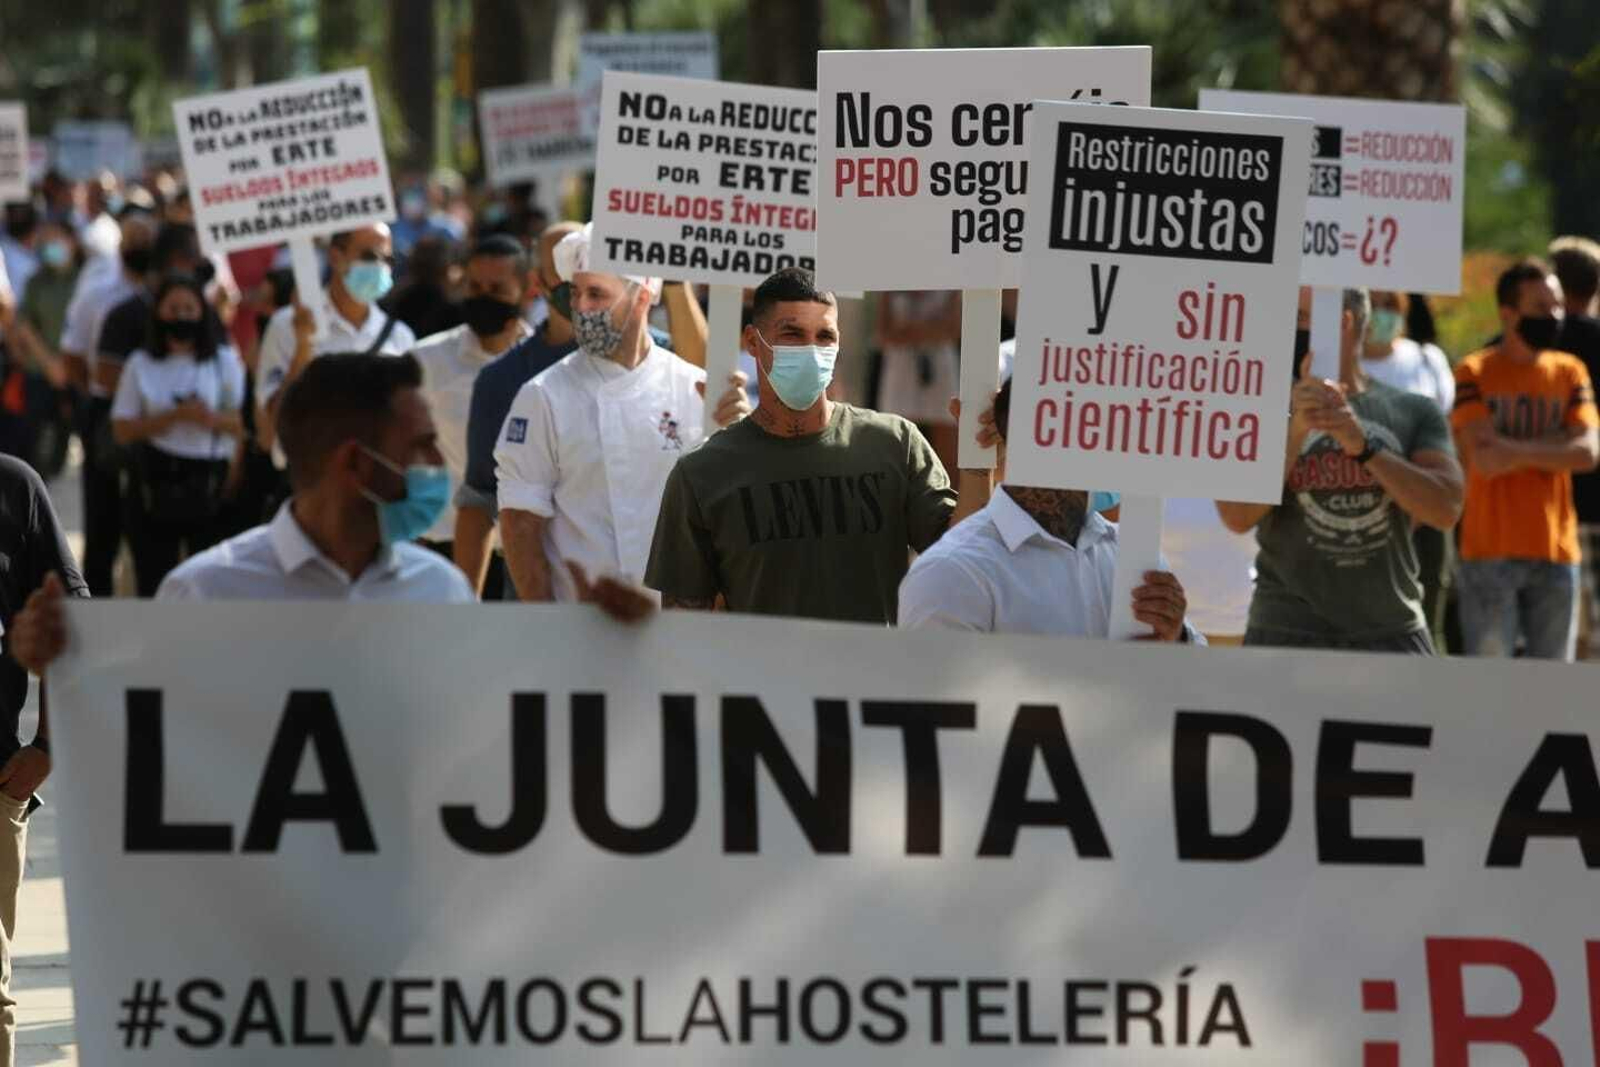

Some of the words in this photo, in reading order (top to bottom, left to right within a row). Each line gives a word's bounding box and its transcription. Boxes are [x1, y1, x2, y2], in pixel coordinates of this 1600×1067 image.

[188, 109, 222, 133] NO
[260, 80, 363, 118] REDUCCIÓN
[618, 91, 668, 121] NO
[669, 105, 682, 121] A
[688, 106, 715, 126] LA
[720, 101, 817, 135] REDUCC
[835, 92, 933, 148] Nos
[193, 137, 216, 154] DE
[222, 132, 246, 150] LA
[251, 110, 367, 142] PRESTACIÓN
[229, 158, 259, 173] POR
[272, 137, 336, 166] ERTE
[617, 125, 651, 146] DE
[657, 129, 691, 151] LA
[657, 165, 700, 185] POR
[719, 162, 811, 195] ERTE
[835, 157, 919, 198] PERO
[1068, 131, 1270, 182] Restricciones
[201, 177, 283, 206] SUELDOS
[258, 196, 298, 211] PARA
[608, 189, 724, 222] SUELDOS
[209, 195, 386, 242] TRABAJADORES
[681, 225, 738, 245] PARA
[743, 231, 785, 250] LOS
[1062, 177, 1265, 254] injustas
[1087, 263, 1120, 335] y
[1176, 282, 1246, 342] sin
[1038, 338, 1264, 396] justificación
[1034, 391, 1260, 462] científica
[738, 473, 884, 545] LEVI'S
[123, 688, 380, 854] LA
[439, 691, 1113, 859] JUNTA
[1171, 709, 1433, 867] DE
[118, 966, 1252, 1049] #SALVEMOSLAHOSTELERÍA
